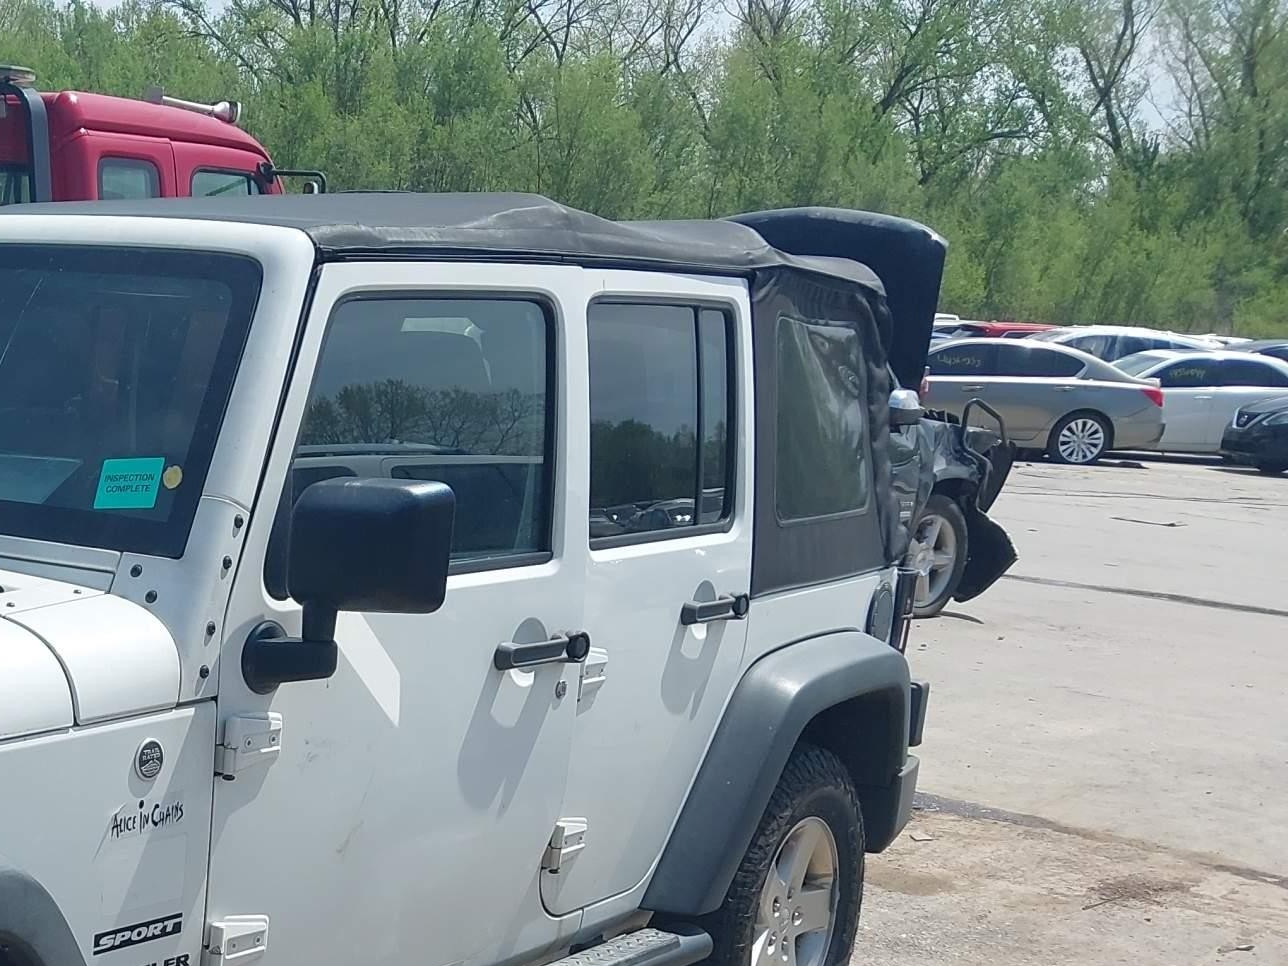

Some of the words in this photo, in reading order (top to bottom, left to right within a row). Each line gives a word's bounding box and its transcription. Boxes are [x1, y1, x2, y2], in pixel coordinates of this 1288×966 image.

[105, 473, 154, 482] INSPECTION
[106, 484, 151, 493] COMPLETE
[98, 920, 176, 947] SPORT
